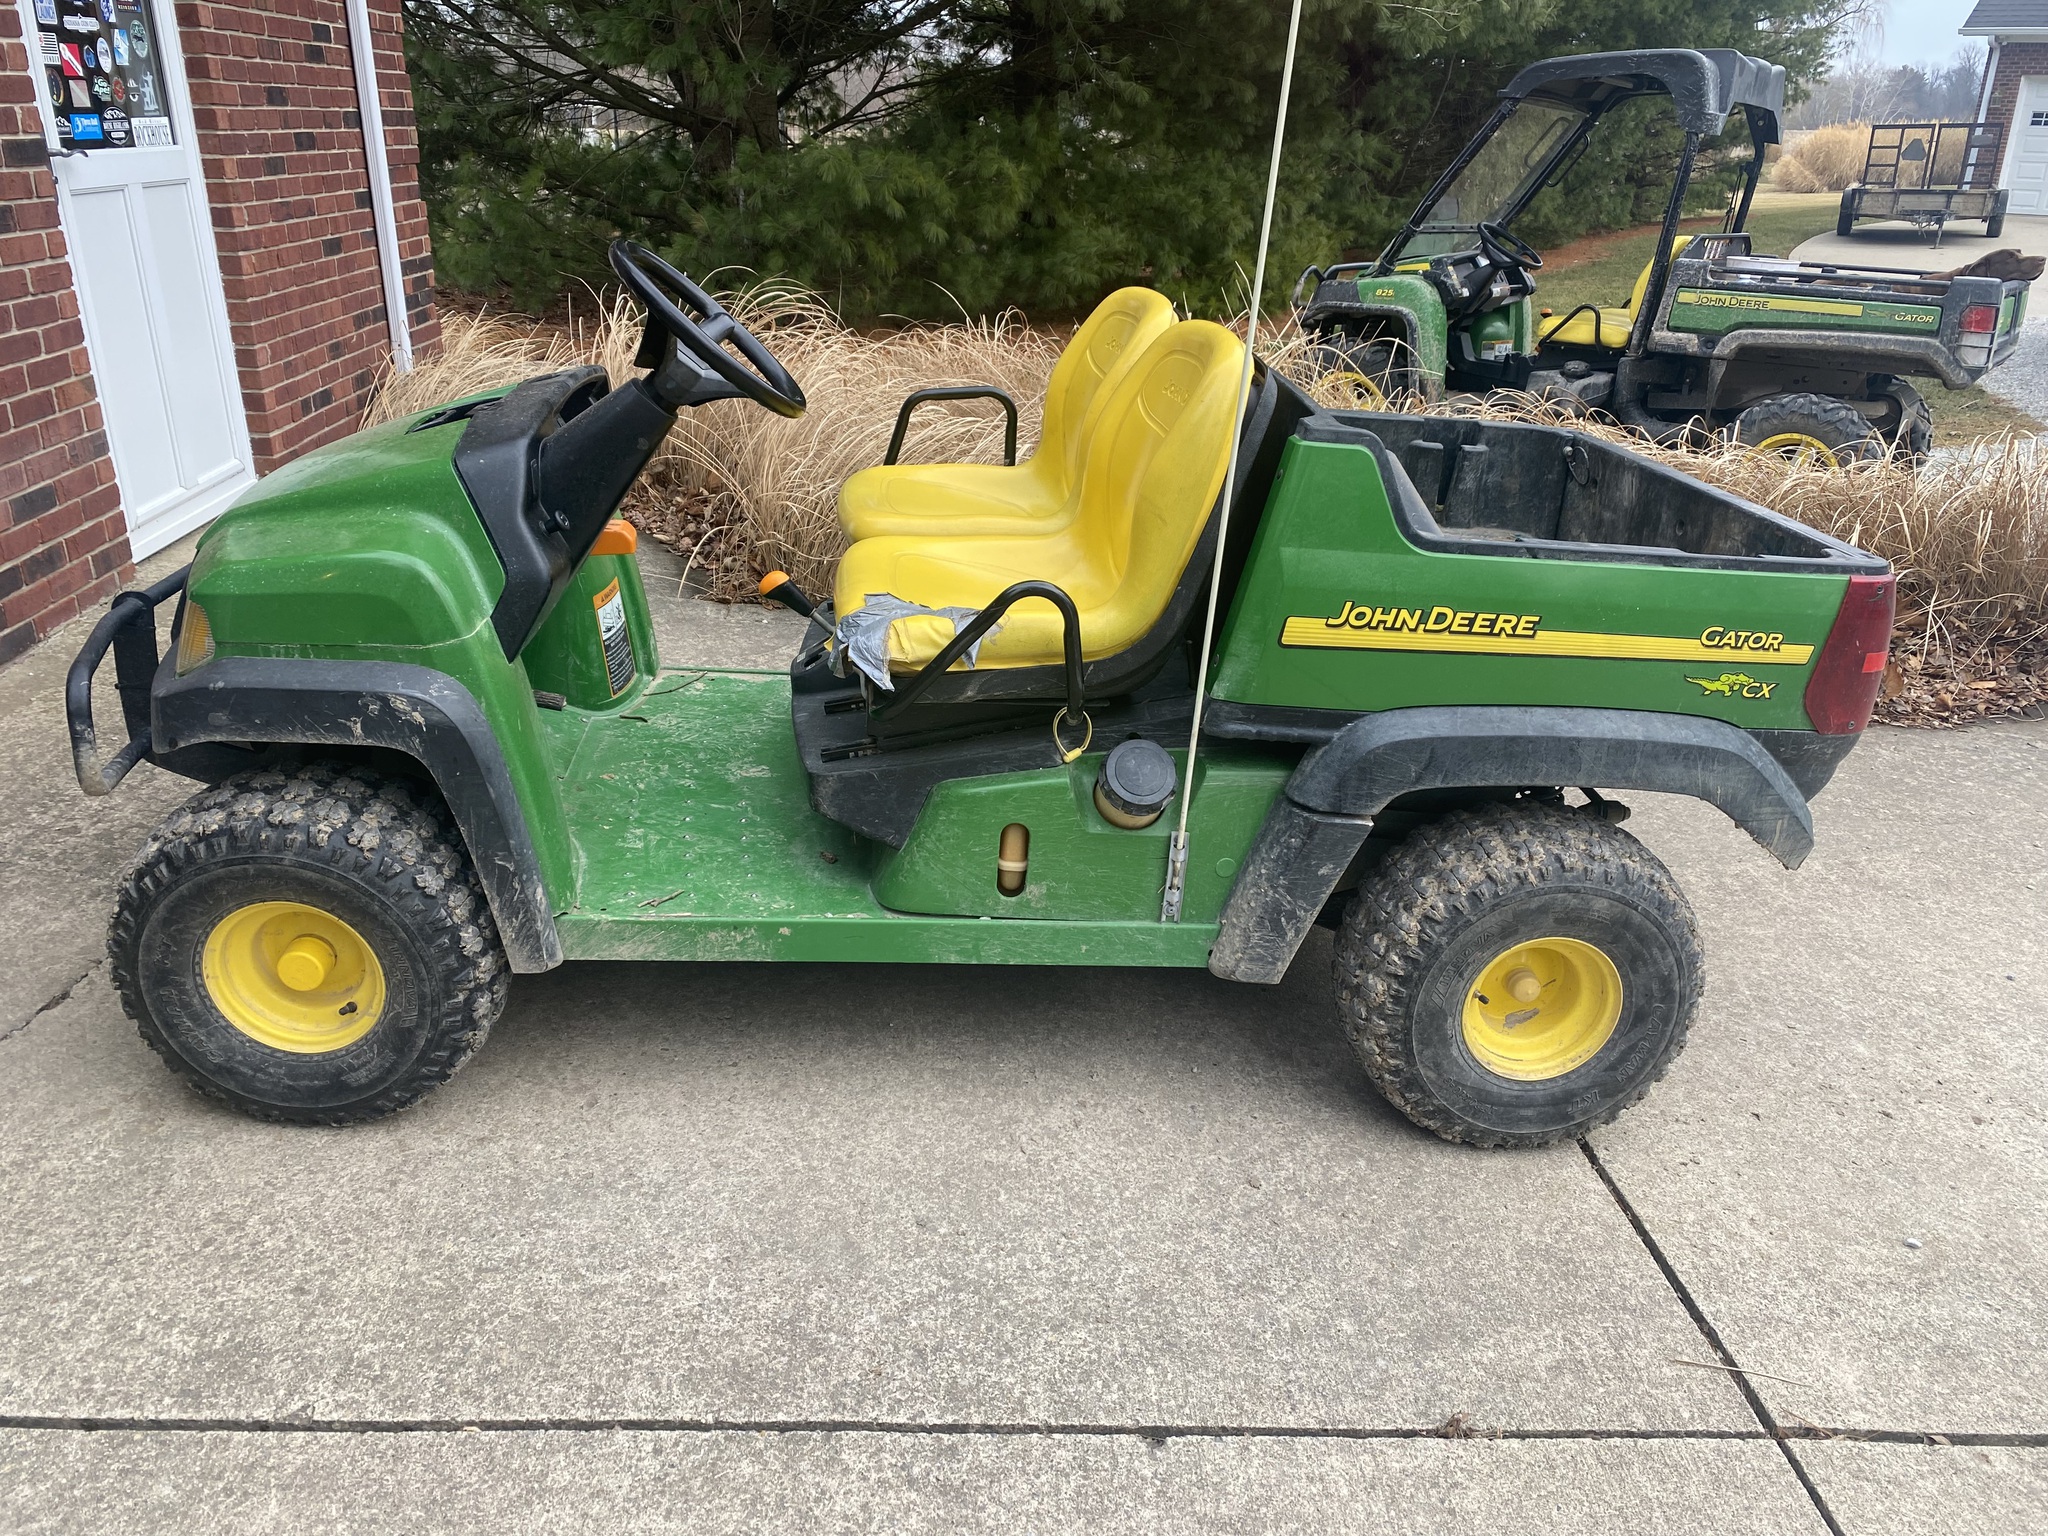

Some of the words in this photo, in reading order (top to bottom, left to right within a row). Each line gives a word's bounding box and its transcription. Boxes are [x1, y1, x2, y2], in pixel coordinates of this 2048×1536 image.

[1693, 293, 1730, 307] JOHN
[1729, 296, 1770, 309] DEERE
[1894, 312, 1935, 324] GATOR
[1325, 601, 1424, 632] JOHN
[1423, 605, 1543, 638] DEERE
[1700, 625, 1784, 651] GATOR
[1741, 682, 1779, 700] CX
